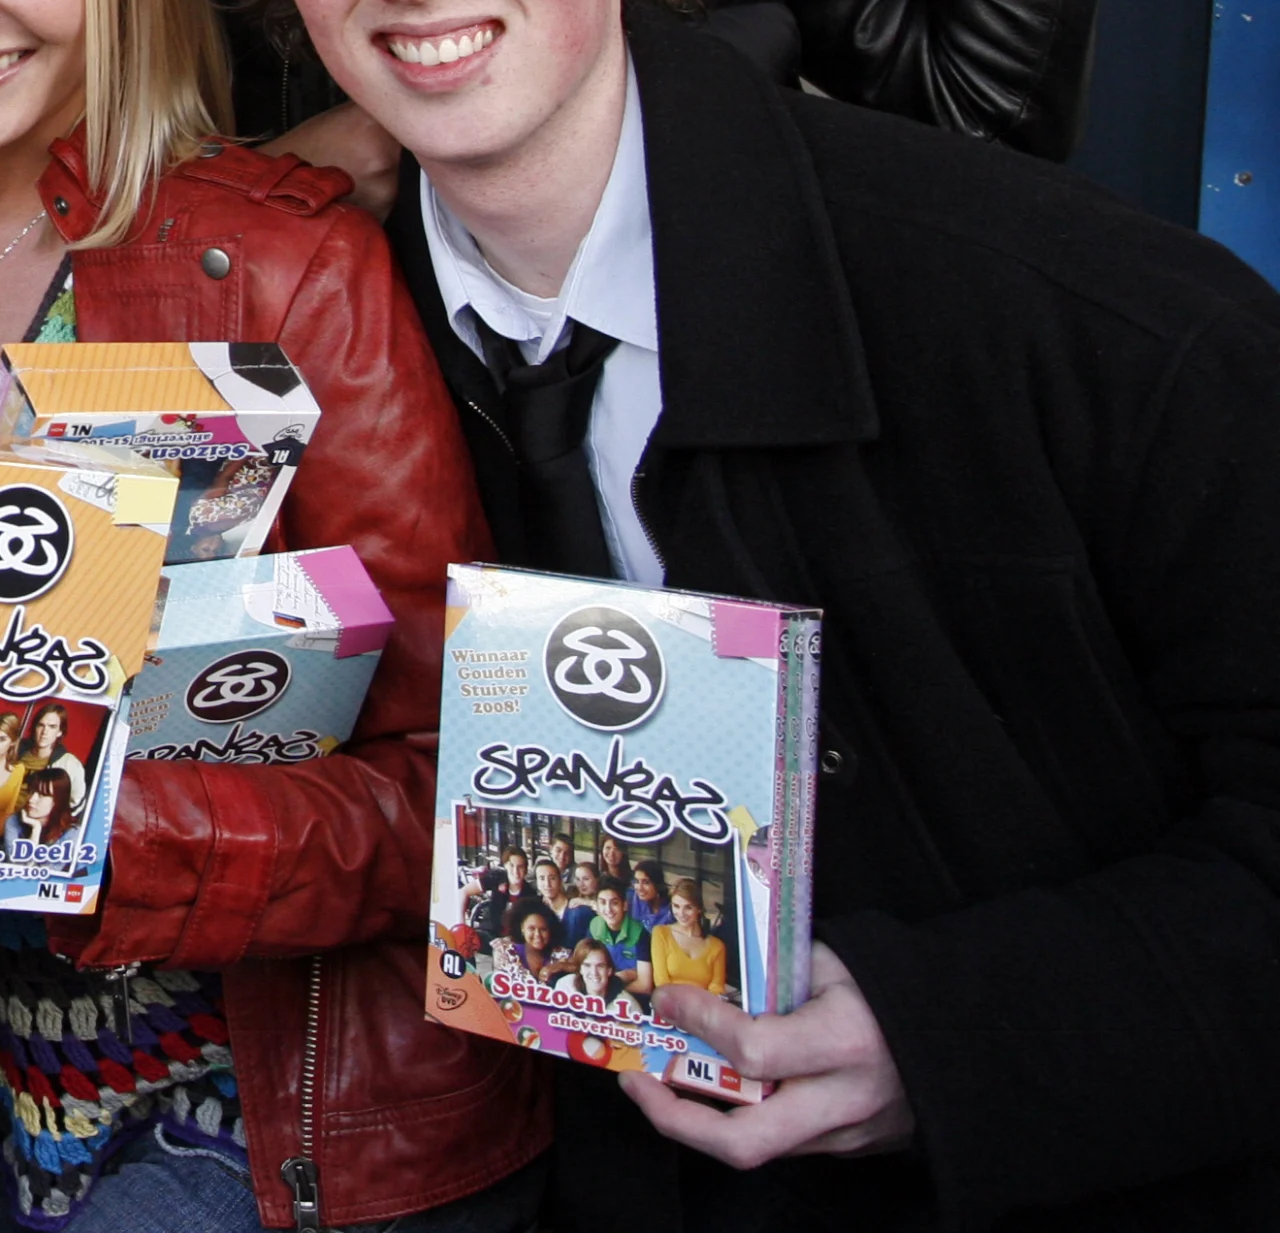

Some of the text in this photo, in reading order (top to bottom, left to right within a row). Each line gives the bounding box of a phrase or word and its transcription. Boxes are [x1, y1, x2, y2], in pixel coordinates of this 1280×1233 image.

[71, 425, 92, 436] NL
[152, 443, 249, 460] Seizoen
[272, 449, 290, 464] AL
[450, 649, 528, 664] Winnaar
[458, 666, 527, 680] Gouden
[460, 683, 528, 697] Stuiver
[472, 700, 521, 714] 2008!
[14, 841, 72, 861] Deel
[78, 844, 96, 863] 2
[39, 884, 59, 899] NL
[443, 954, 461, 976] AL
[492, 973, 607, 1015] Seizoen
[549, 1013, 642, 1044] aflevering:
[646, 1032, 687, 1052] 1-50
[687, 1059, 714, 1081] NL
